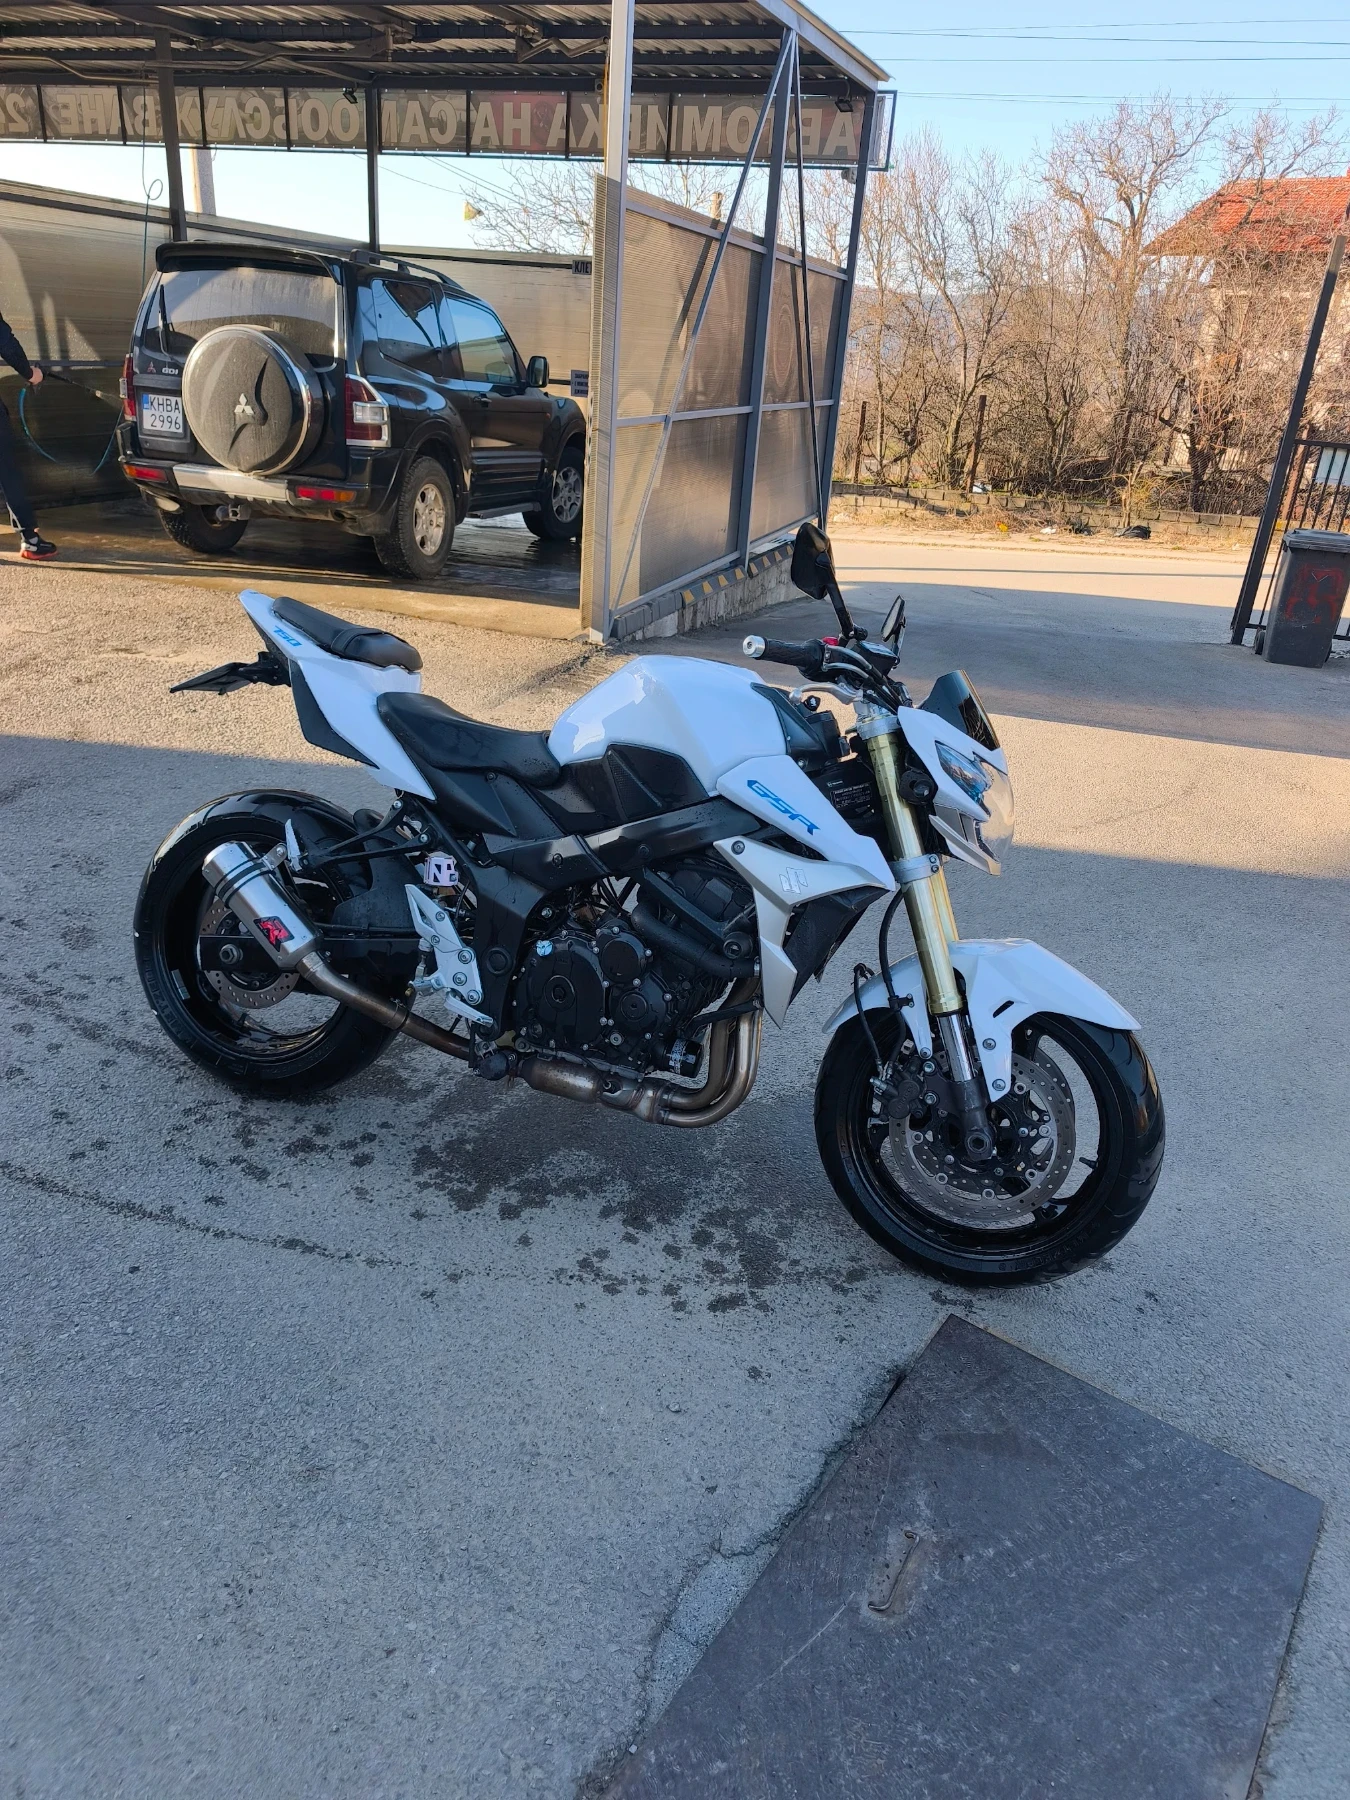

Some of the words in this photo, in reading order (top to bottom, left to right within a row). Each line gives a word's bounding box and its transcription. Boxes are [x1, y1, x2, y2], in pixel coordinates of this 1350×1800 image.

[162, 367, 179, 375] GDI
[150, 414, 181, 430] 2996
[747, 780, 821, 836] GSR
